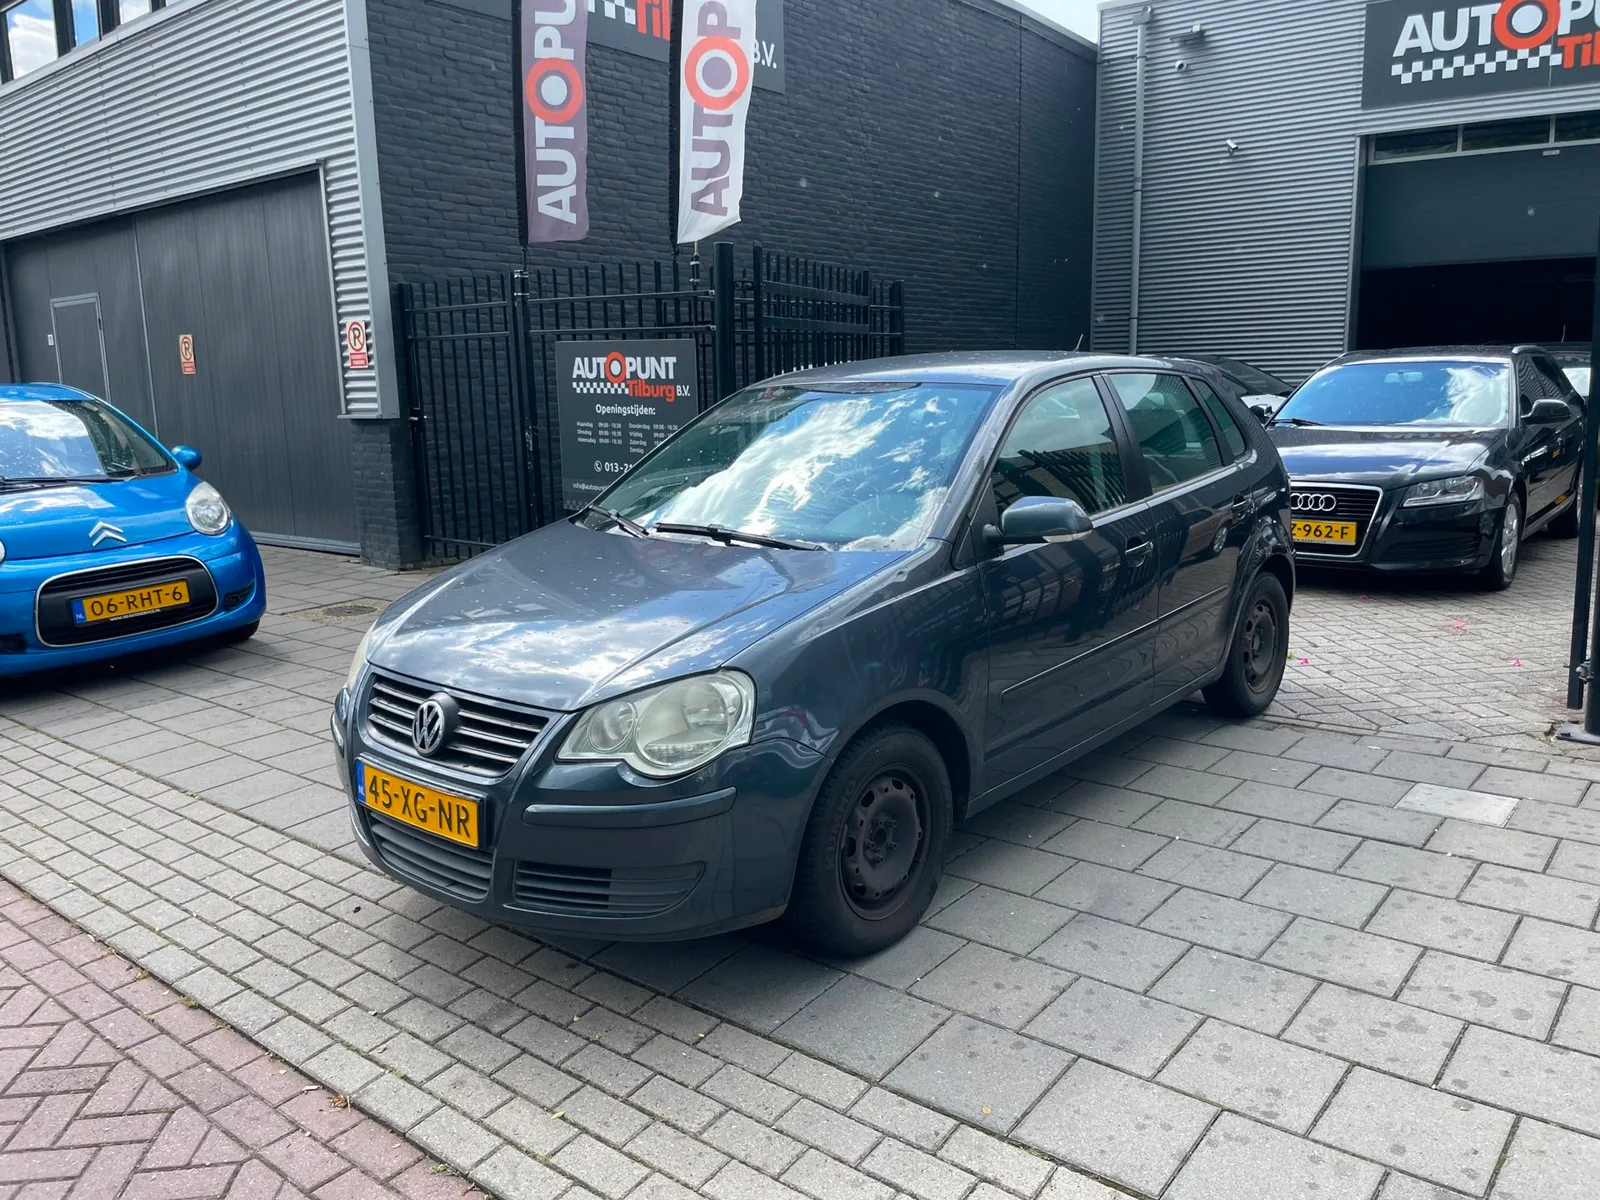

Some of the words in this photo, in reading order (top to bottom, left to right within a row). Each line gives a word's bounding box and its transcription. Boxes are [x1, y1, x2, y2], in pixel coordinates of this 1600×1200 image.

[1392, 0, 1600, 58] AUTOP
[572, 351, 677, 384] AUTOPUNT
[627, 379, 676, 402] Tilburg
[676, 385, 691, 397] B.V.
[595, 404, 656, 417] Openingstijden:
[75, 612, 85, 620] NL
[90, 586, 183, 617] 06-RHT-6
[368, 774, 471, 838] 45-XG-NR
